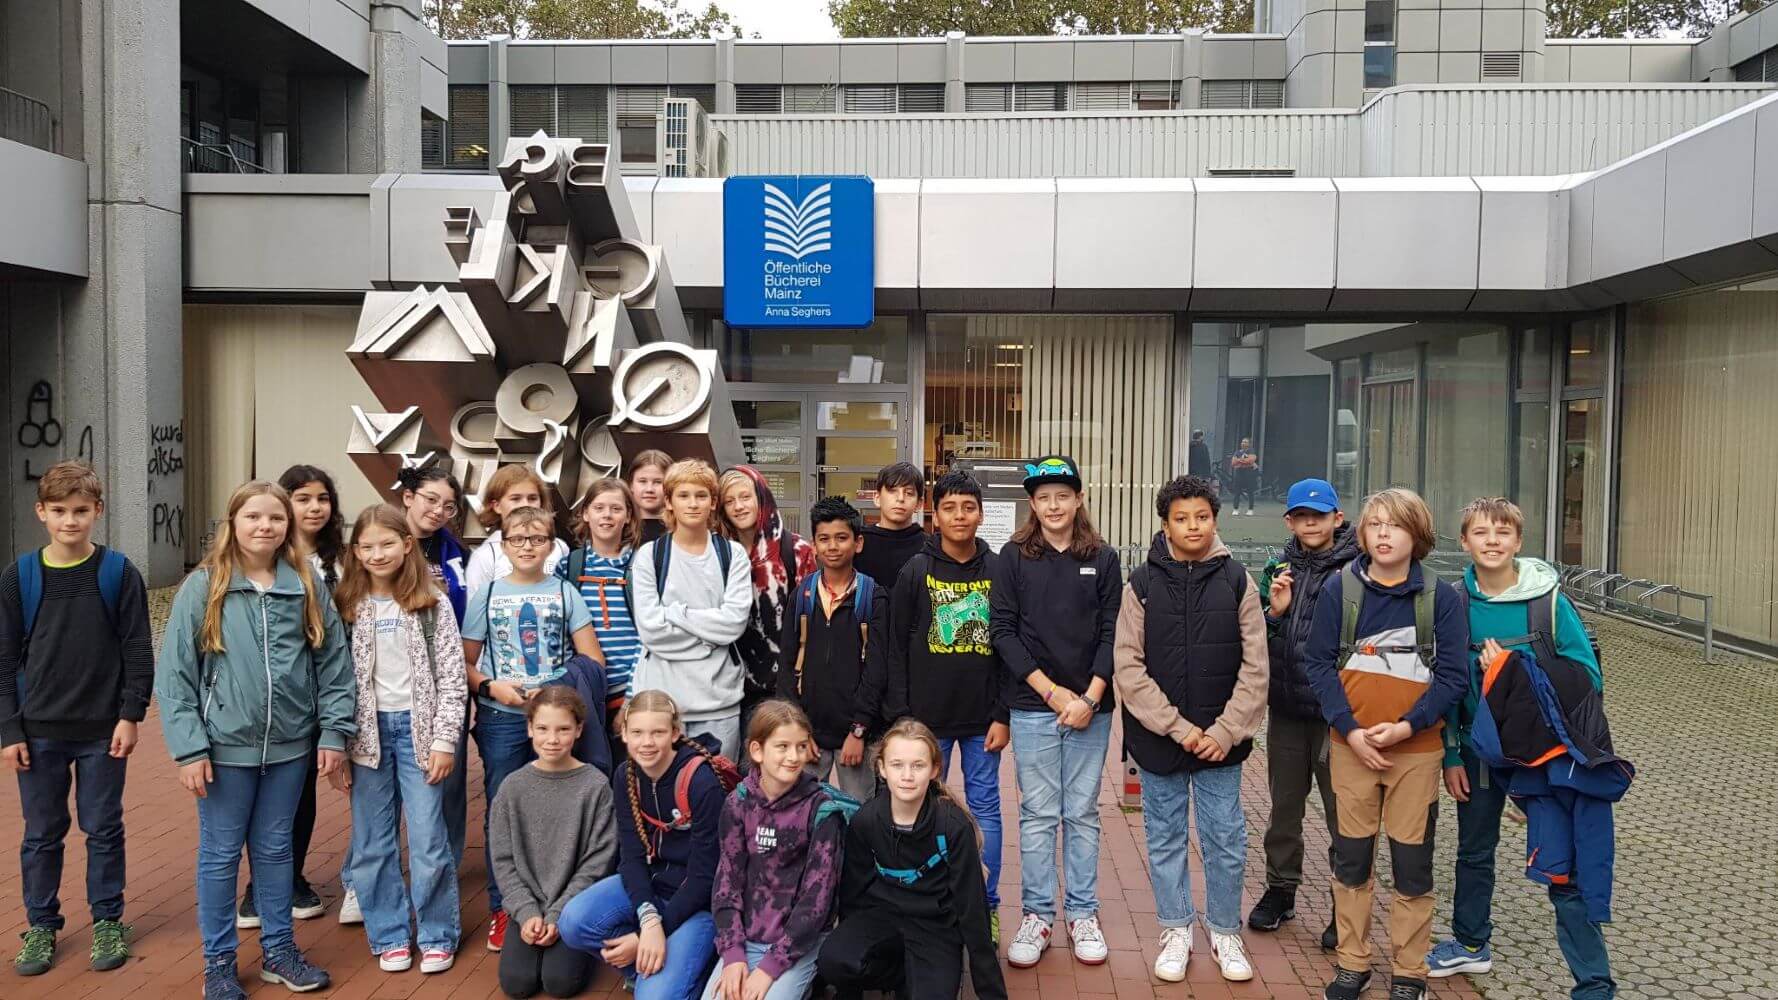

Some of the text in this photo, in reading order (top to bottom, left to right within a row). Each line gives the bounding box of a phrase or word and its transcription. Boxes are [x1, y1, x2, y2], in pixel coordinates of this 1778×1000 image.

[764, 259, 831, 273] Öffentliche
[764, 275, 821, 287] Bücherei
[764, 288, 802, 300] Mainz
[765, 307, 831, 317] Anna Seghers
[926, 574, 968, 593] NEVER
